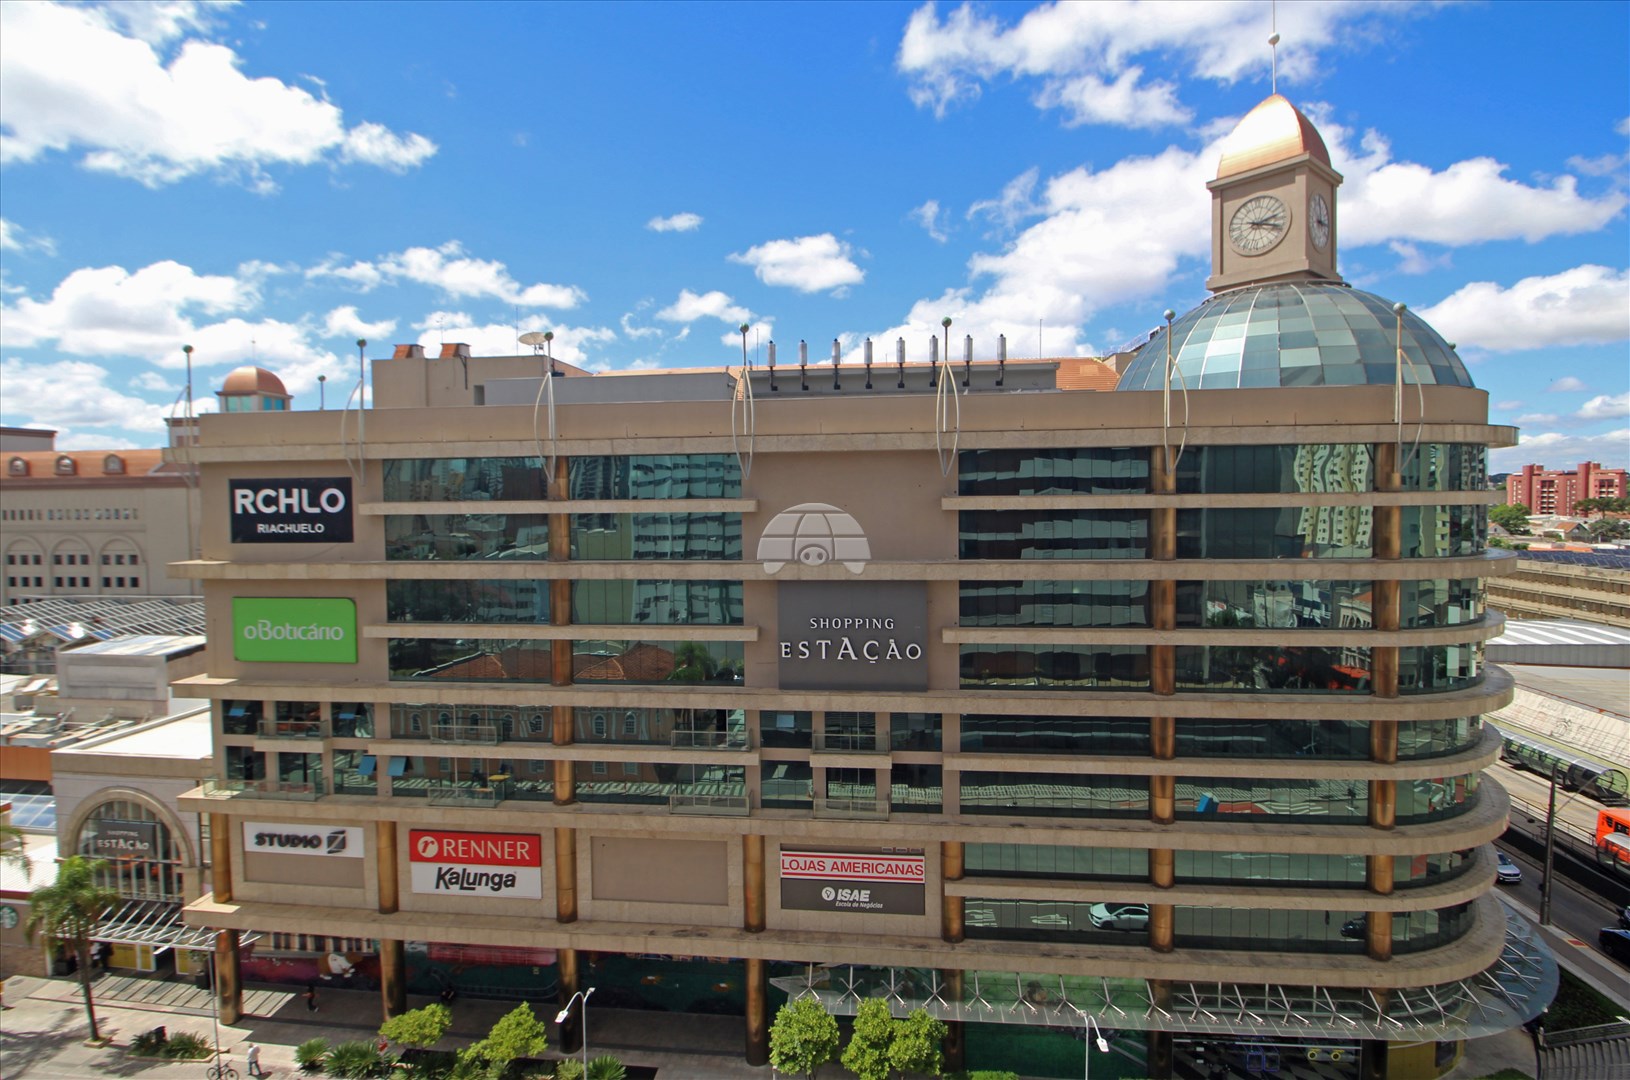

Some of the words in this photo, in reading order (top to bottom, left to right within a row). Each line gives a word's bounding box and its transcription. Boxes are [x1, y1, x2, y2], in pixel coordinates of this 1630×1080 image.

[234, 488, 345, 514] RCHLO
[257, 523, 325, 533] RIACHUELO
[809, 617, 895, 630] SHOPPING
[780, 637, 922, 664] ESTAÇÃO
[97, 839, 150, 850] ESTAÇÃO
[255, 832, 322, 849] STUDIO
[443, 839, 530, 860] RENNER
[781, 859, 826, 872] LOJAS
[830, 861, 924, 876] AMERICANAS
[837, 888, 871, 902] ISAE
[835, 900, 851, 908] Escola
[859, 902, 884, 910] Negócios
